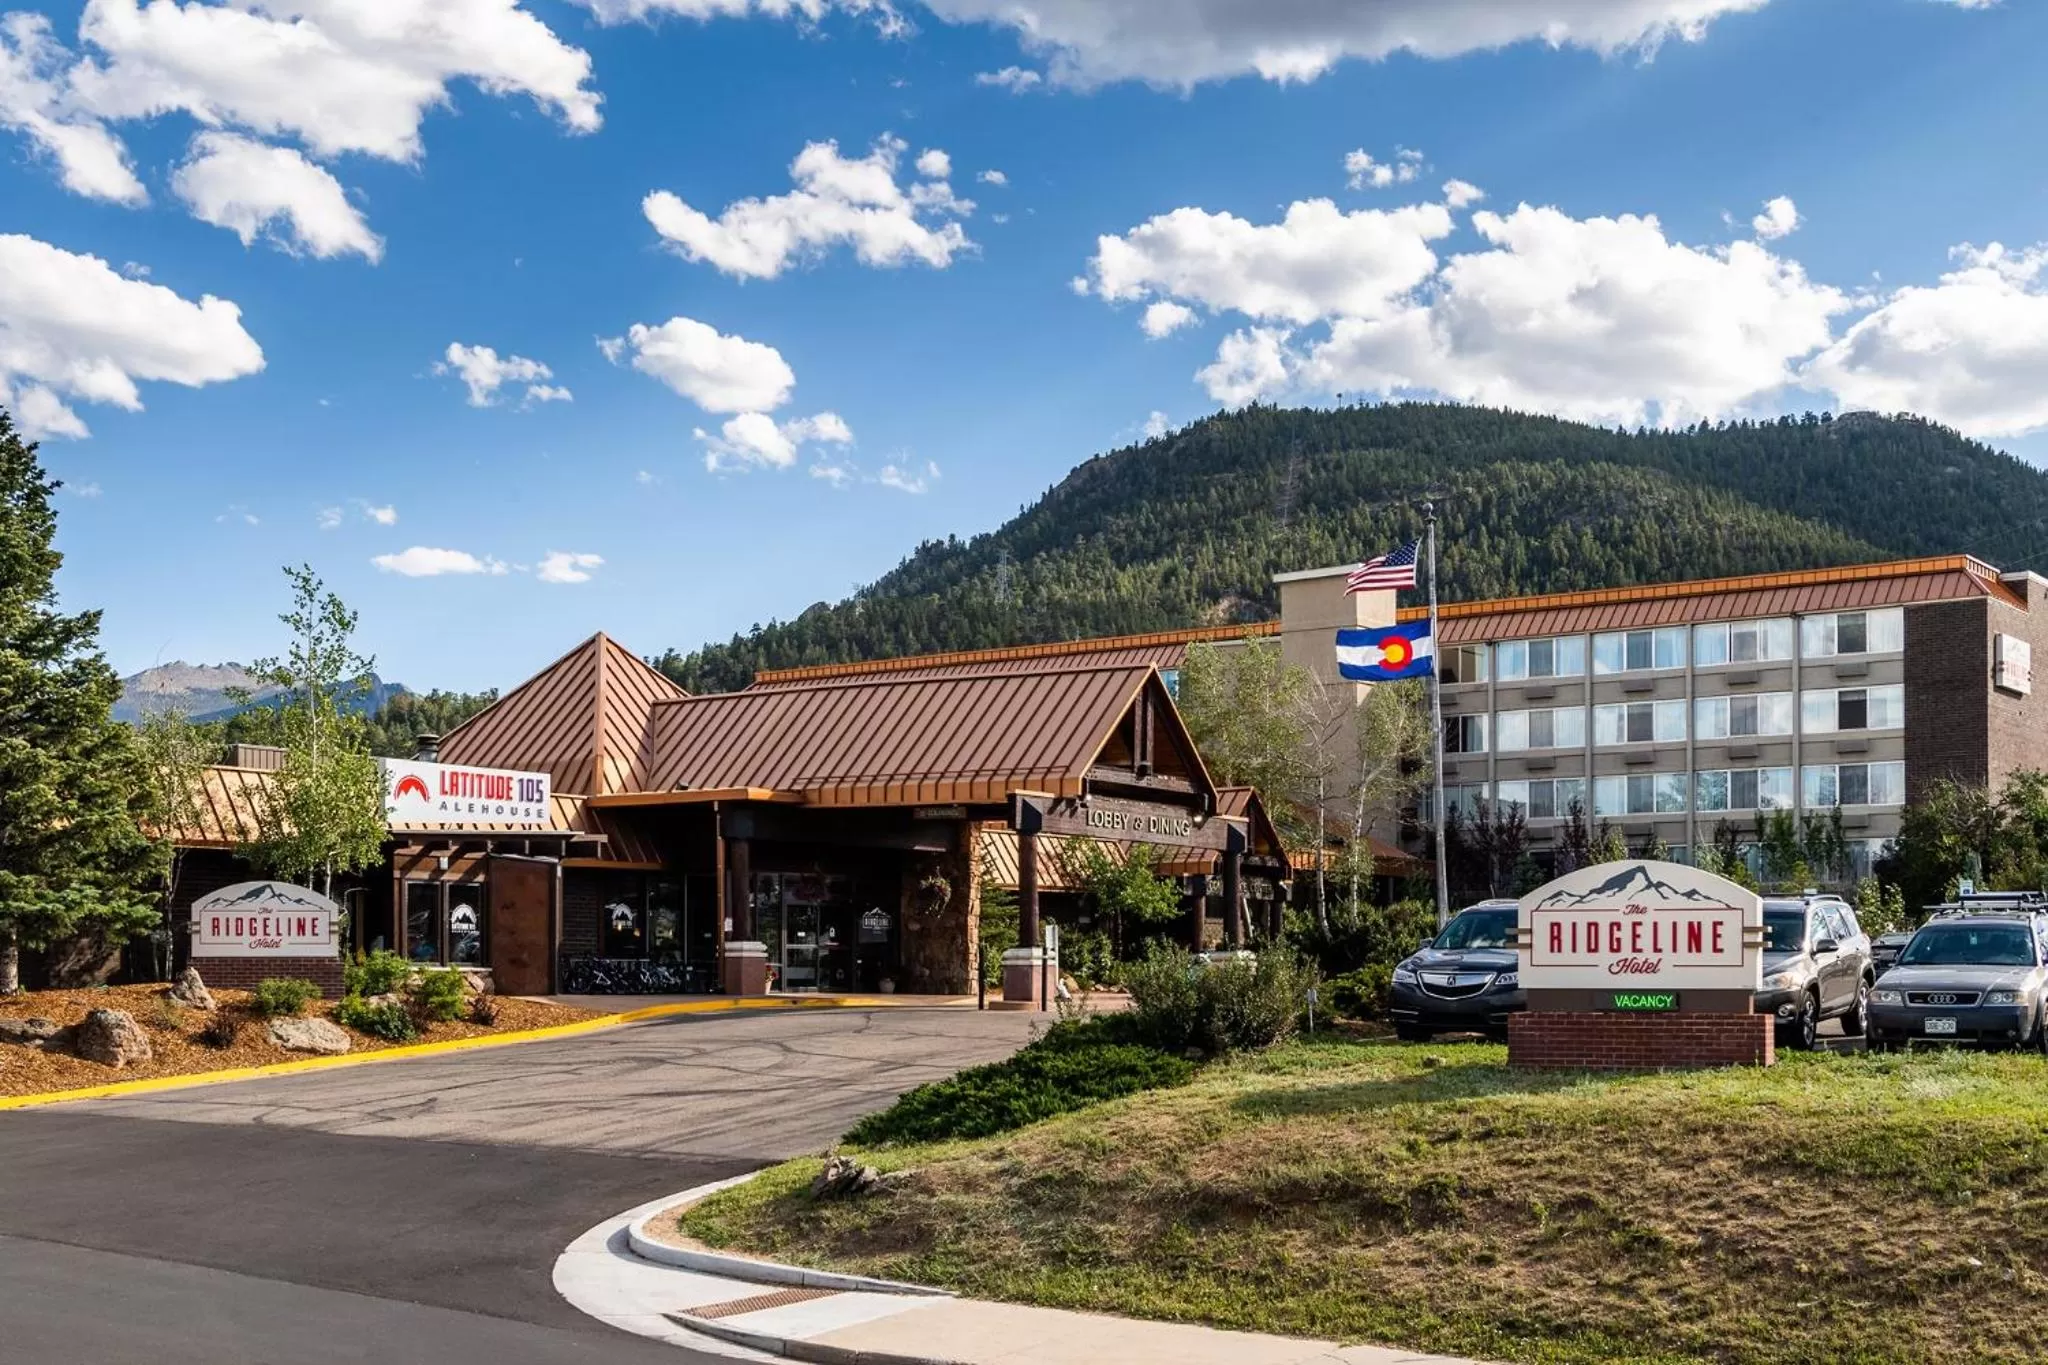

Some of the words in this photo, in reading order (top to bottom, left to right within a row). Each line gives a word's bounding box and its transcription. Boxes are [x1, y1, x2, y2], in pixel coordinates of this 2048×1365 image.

[439, 770, 514, 800] LATITUDE
[517, 778, 544, 804] 105
[439, 801, 544, 818] ALEHOUSE
[1086, 810, 1130, 830] LOBBY
[1134, 817, 1145, 830] &
[1149, 816, 1191, 836] DINING
[1622, 904, 1648, 916] The
[211, 917, 320, 937] RIDGELINE
[1549, 920, 1725, 954] RIDGELINE
[249, 938, 283, 950] Hotel
[1607, 956, 1663, 976] Hotel
[1614, 994, 1674, 1008] VACANCY
